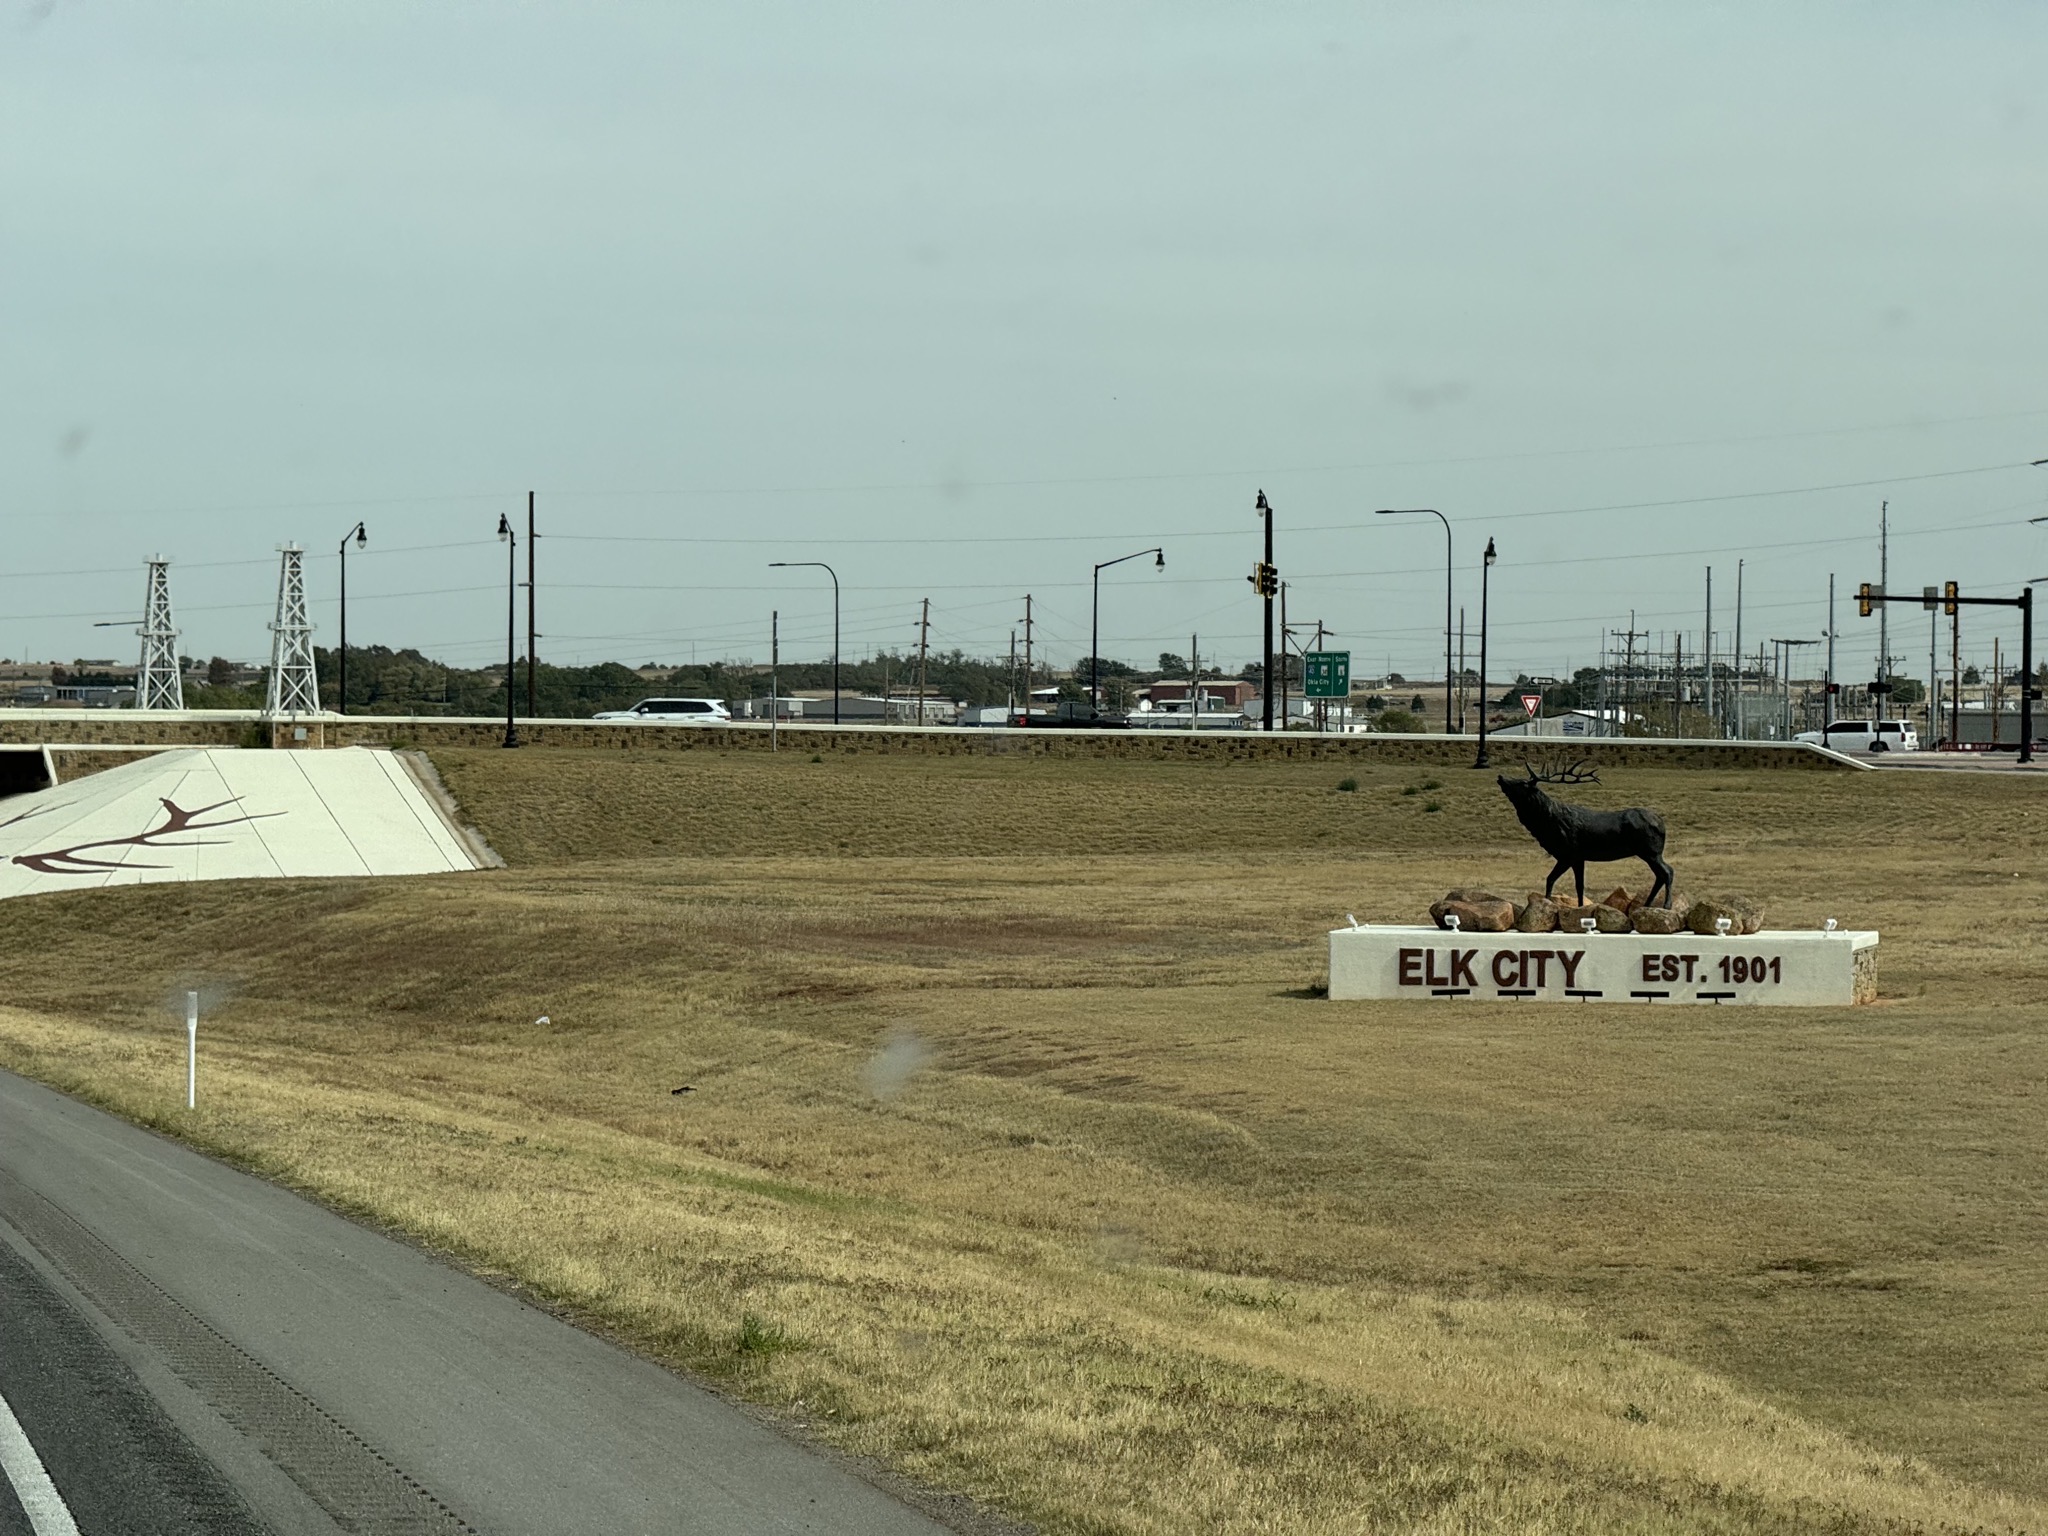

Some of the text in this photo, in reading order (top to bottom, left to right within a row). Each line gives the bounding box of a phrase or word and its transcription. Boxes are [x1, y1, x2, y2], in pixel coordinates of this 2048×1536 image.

[1399, 948, 1781, 988] ELK CITY EST. 1901
